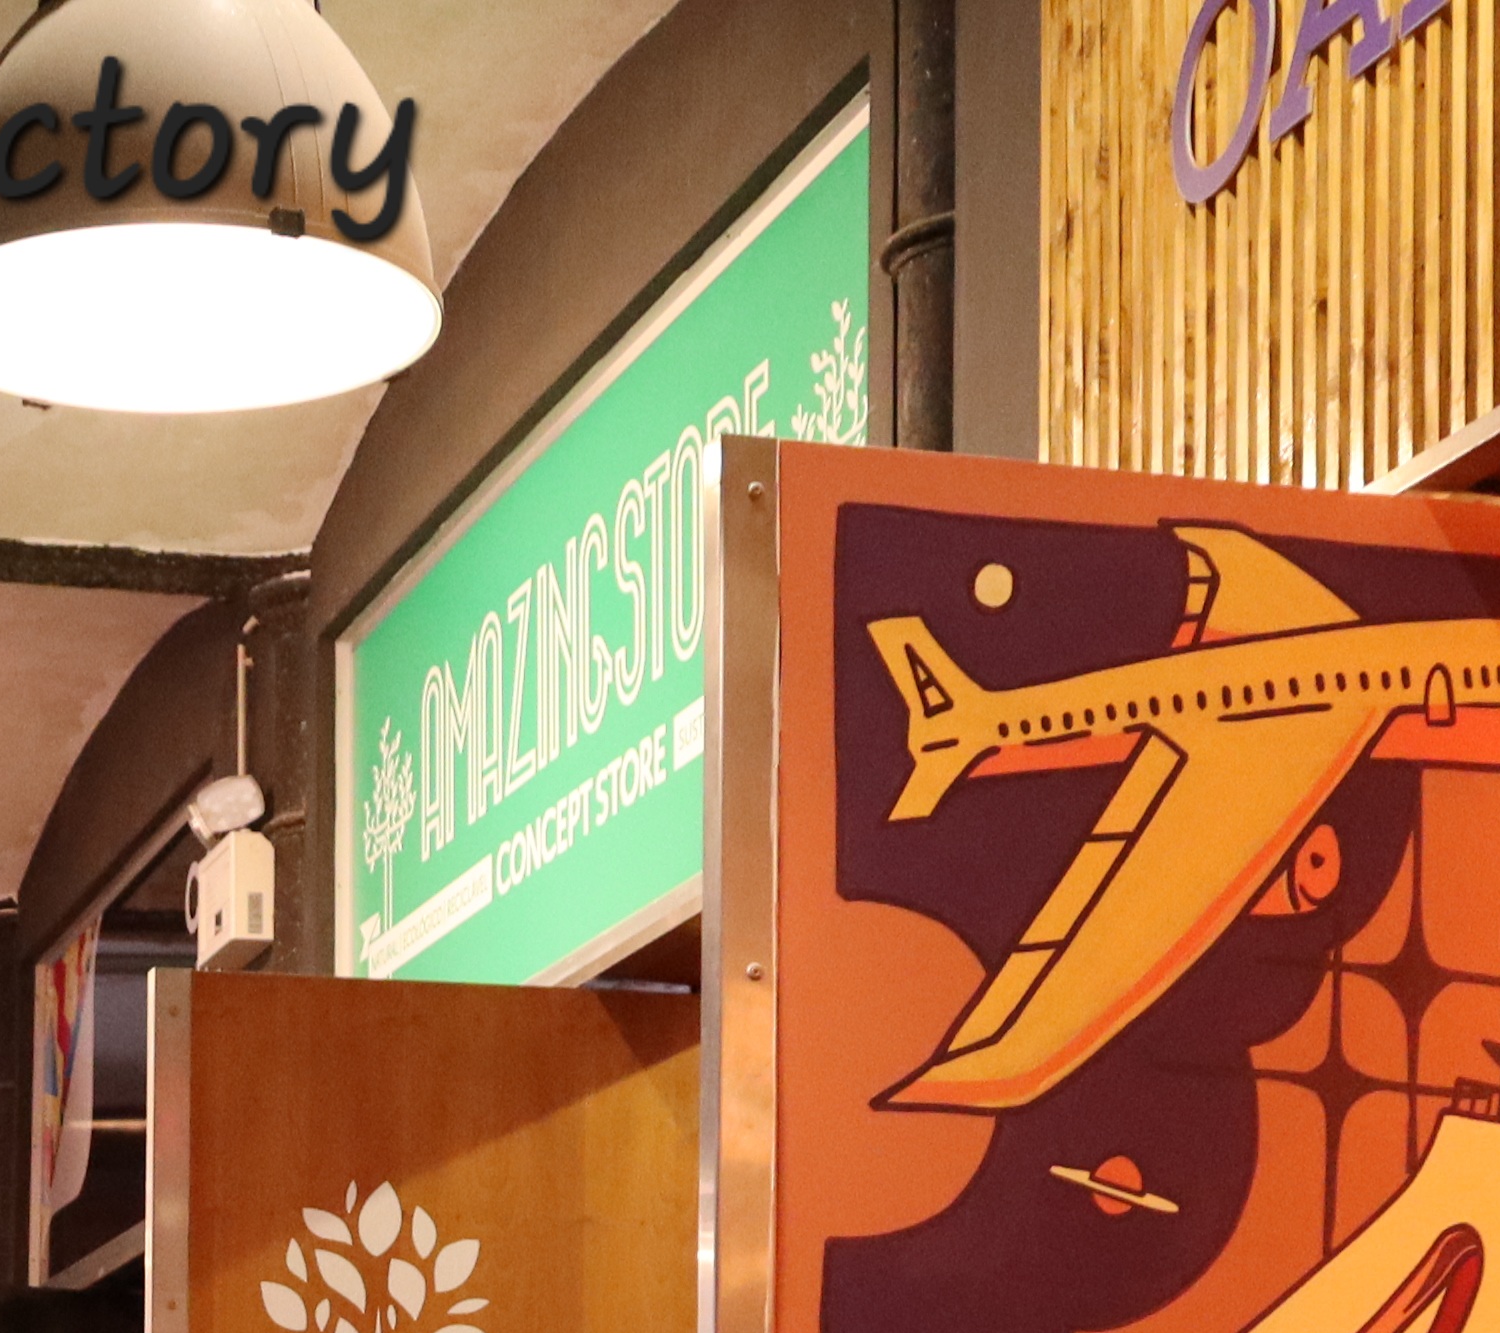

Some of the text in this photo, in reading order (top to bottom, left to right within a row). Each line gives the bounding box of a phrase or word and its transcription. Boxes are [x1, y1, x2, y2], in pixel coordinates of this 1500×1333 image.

[614, 359, 775, 706] STO
[496, 723, 667, 896] CONCEPT STORE
